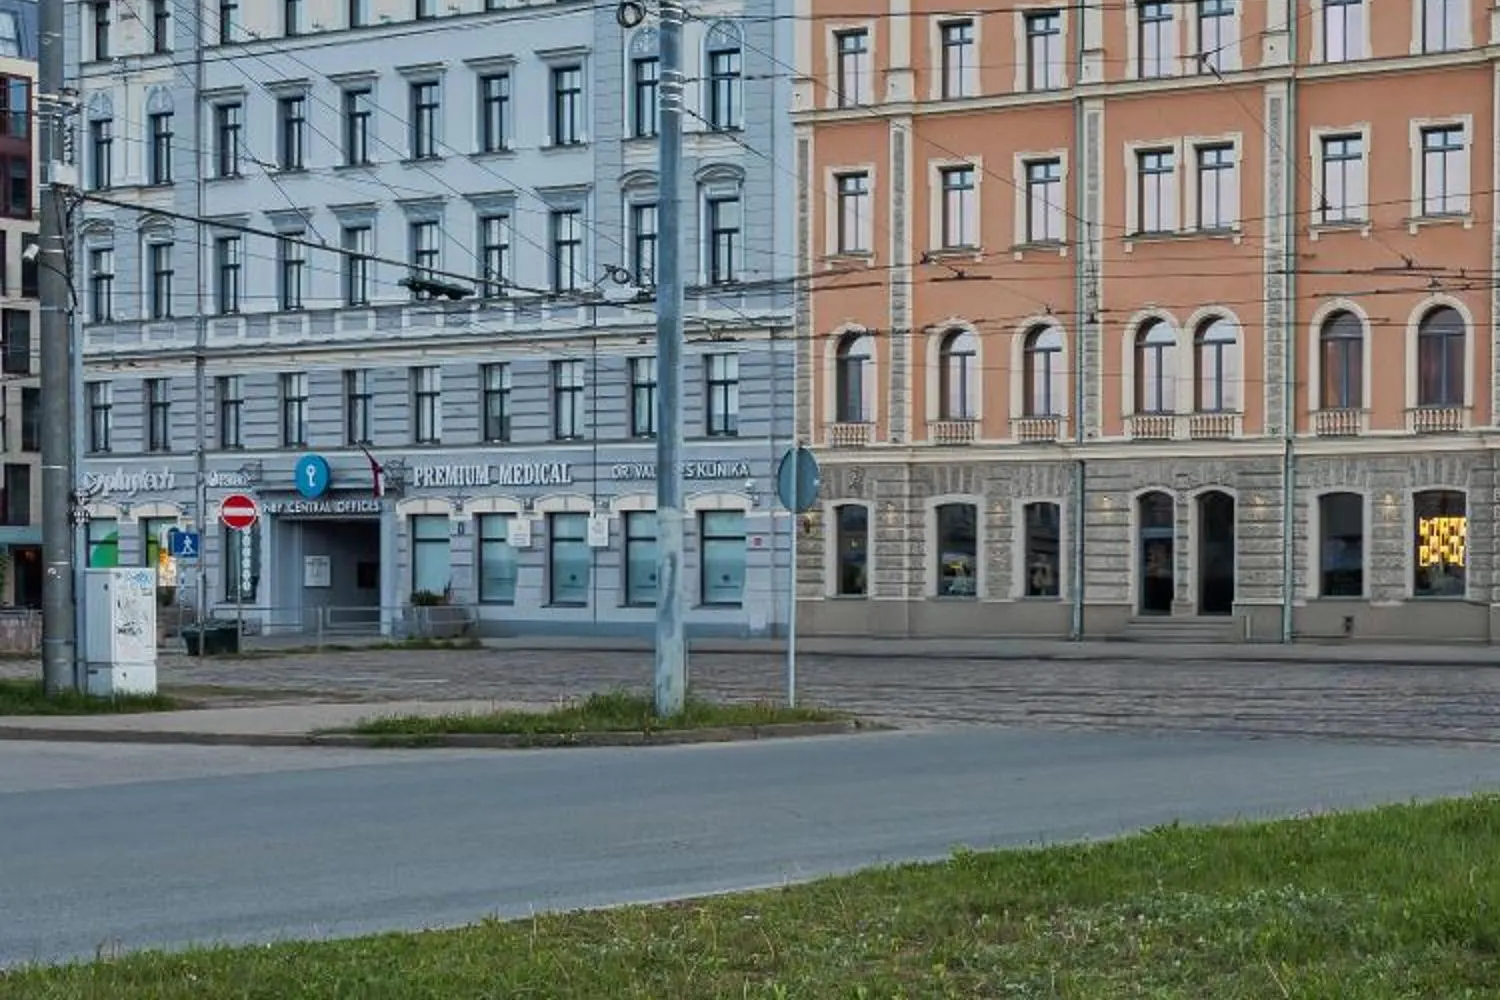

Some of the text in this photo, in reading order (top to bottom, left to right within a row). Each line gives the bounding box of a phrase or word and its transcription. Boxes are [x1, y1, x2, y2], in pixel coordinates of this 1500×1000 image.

[413, 463, 572, 487] PREMIUM MEDICAL
[287, 501, 331, 513] CENTRAL
